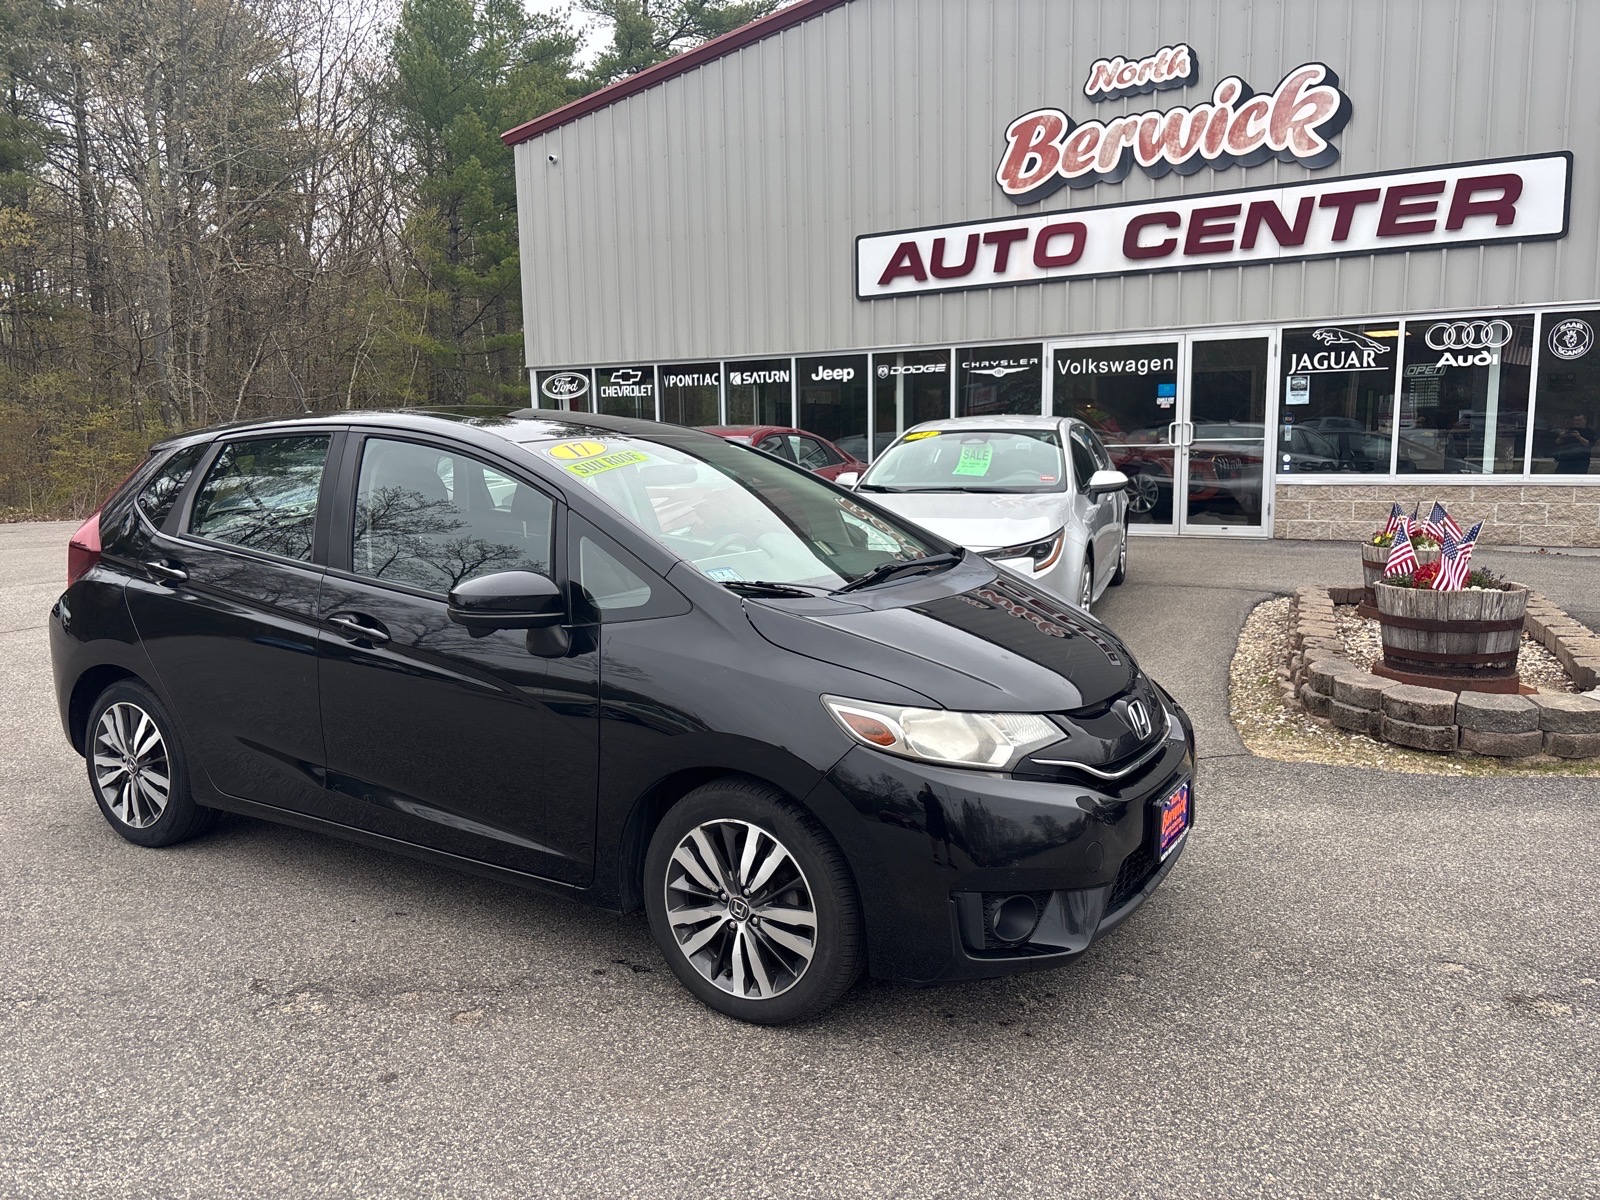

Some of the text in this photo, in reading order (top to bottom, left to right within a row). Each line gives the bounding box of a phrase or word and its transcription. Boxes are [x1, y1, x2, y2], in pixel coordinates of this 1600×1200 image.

[1088, 48, 1188, 91] North
[1000, 69, 1337, 191] Berwick
[877, 173, 1525, 286] AUTO CENTER
[1560, 322, 1584, 330] SAAB
[961, 358, 1039, 368] CHRYSLER
[1057, 358, 1174, 375] Volkswagen
[1288, 349, 1377, 374] JAGUAR
[1435, 350, 1499, 368] Audi
[811, 365, 855, 382] Jeep
[889, 363, 947, 375] DODGE
[1406, 365, 1445, 375] OPEN
[552, 377, 579, 393] Ford
[742, 370, 790, 385] SATURN
[601, 384, 653, 397] CHEVROLET
[563, 442, 591, 457] 17
[963, 449, 990, 461] SALE
[573, 460, 607, 474] SUN
[1299, 461, 1375, 472] SAAB
